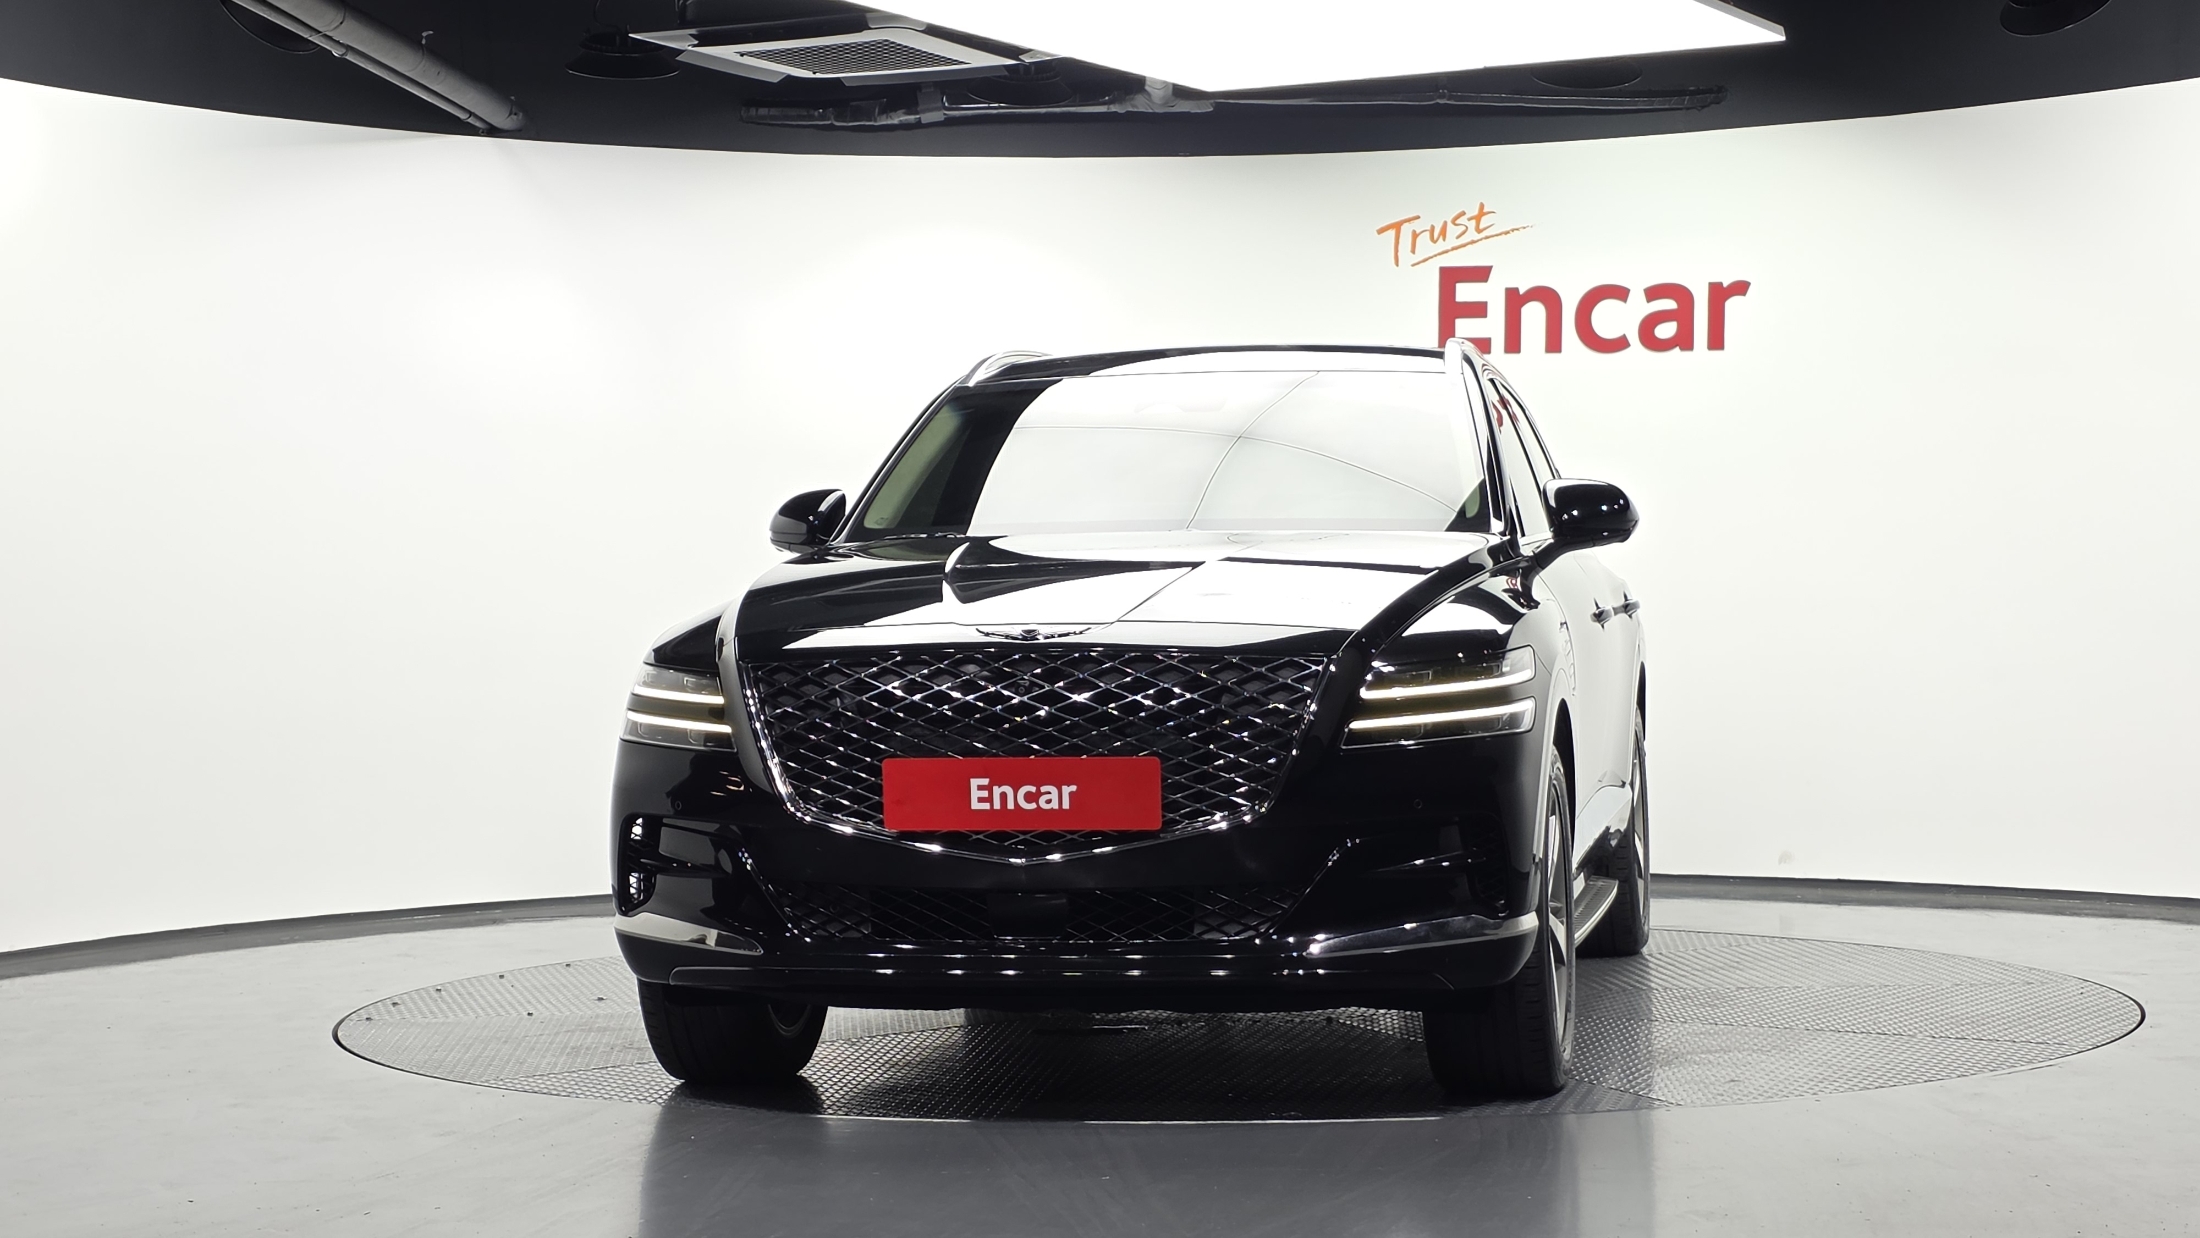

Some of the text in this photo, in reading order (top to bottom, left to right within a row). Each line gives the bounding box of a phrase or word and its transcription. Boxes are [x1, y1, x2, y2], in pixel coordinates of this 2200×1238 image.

[1376, 202, 1497, 267] Trust
[1438, 265, 1751, 354] Encar
[970, 778, 1077, 810] Encar
